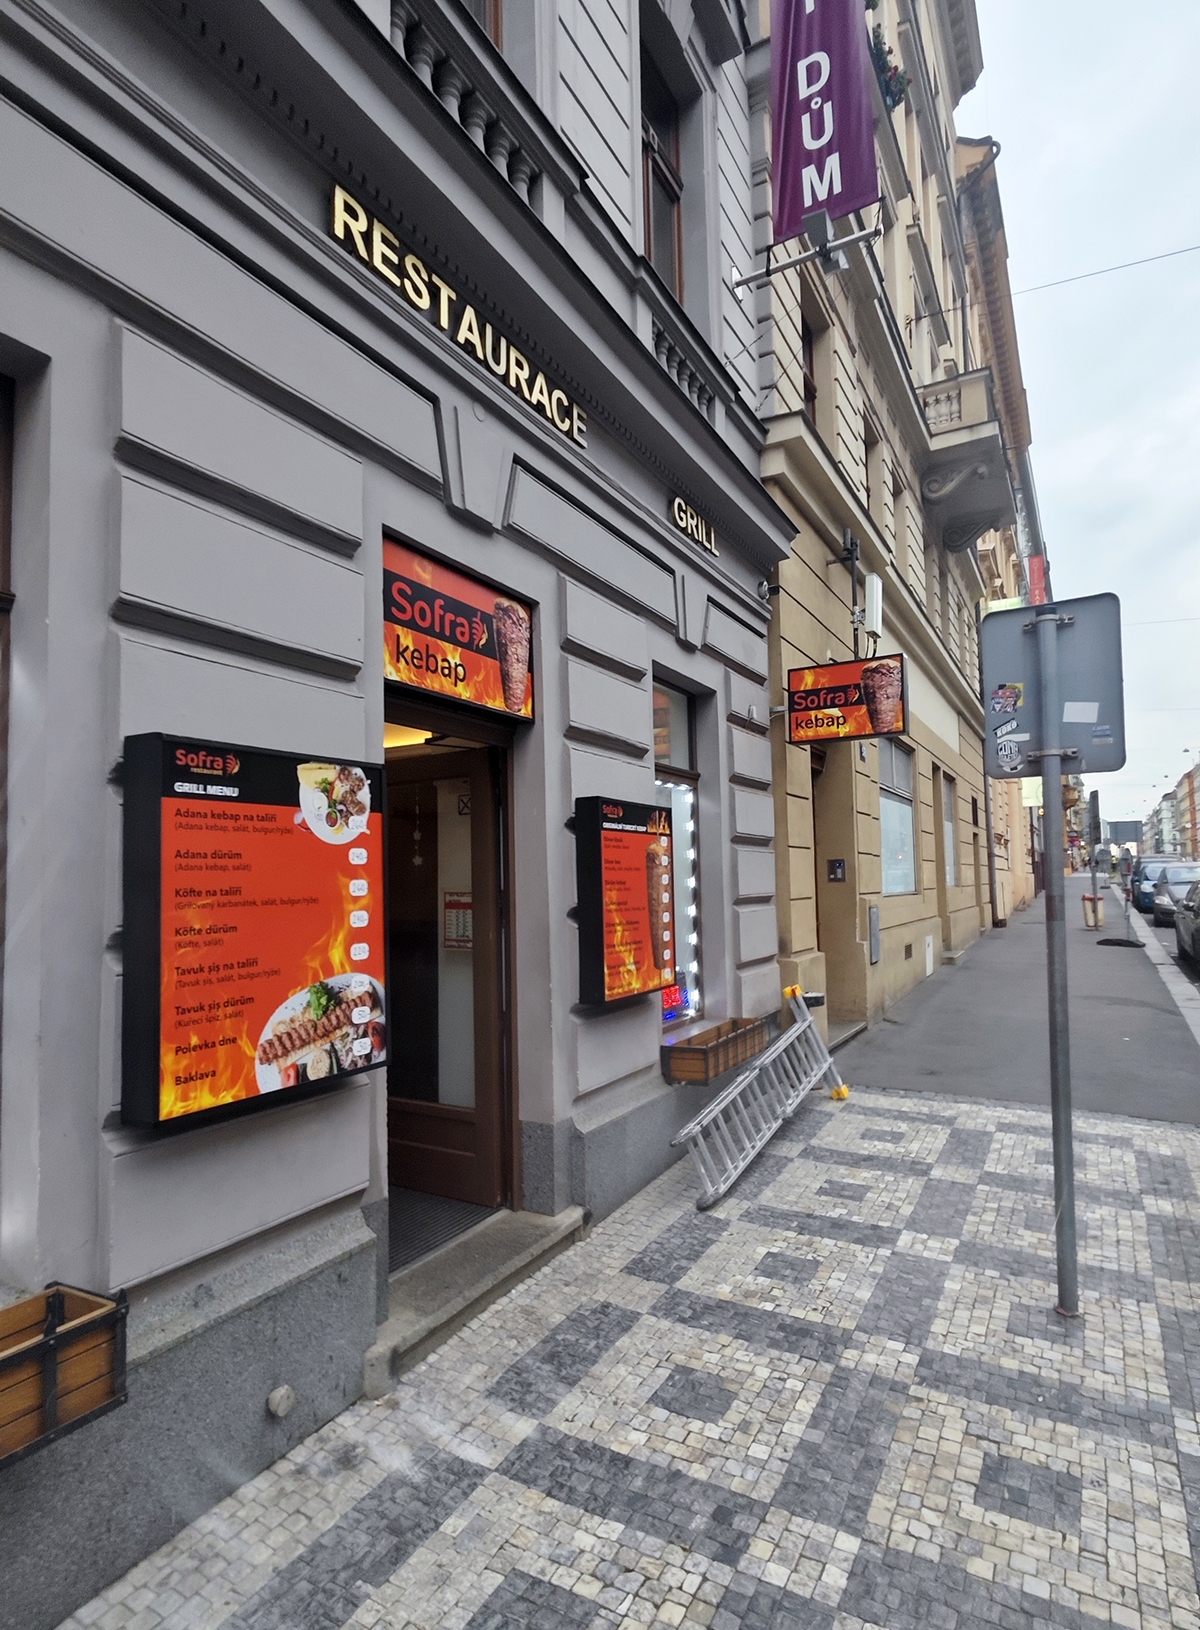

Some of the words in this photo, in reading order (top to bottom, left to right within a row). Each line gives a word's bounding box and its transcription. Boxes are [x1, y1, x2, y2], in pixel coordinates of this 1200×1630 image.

[797, 51, 842, 208] DŮM
[333, 184, 588, 449] RESTAURACE
[672, 496, 720, 557] GRILL
[391, 581, 470, 643] Sofra
[396, 634, 467, 688] kebap
[794, 690, 845, 709] Sofra
[795, 714, 846, 730] kebap
[175, 749, 223, 769] Sofra
[174, 782, 206, 794] GRILL
[206, 785, 239, 797] MENU
[175, 808, 208, 819] Adana
[211, 810, 241, 823] kebap
[174, 822, 203, 831] (Adana
[205, 823, 230, 833] kebap,
[175, 849, 208, 859] Adana
[211, 850, 242, 859] dürüm
[174, 863, 203, 872] (Adana
[175, 888, 203, 898] Köfte
[205, 889, 217, 897] na
[175, 926, 203, 937] Köfte
[205, 924, 238, 935] dürüm
[175, 964, 205, 976] Tavuk
[207, 963, 221, 975] şiş
[223, 962, 235, 971] na
[175, 978, 201, 990] (Tavuk
[175, 1002, 206, 1016] Tavuk
[208, 1000, 221, 1013] şiş
[223, 996, 255, 1008] dürüm
[218, 1035, 238, 1047] dne
[175, 1069, 216, 1086] Baklava
